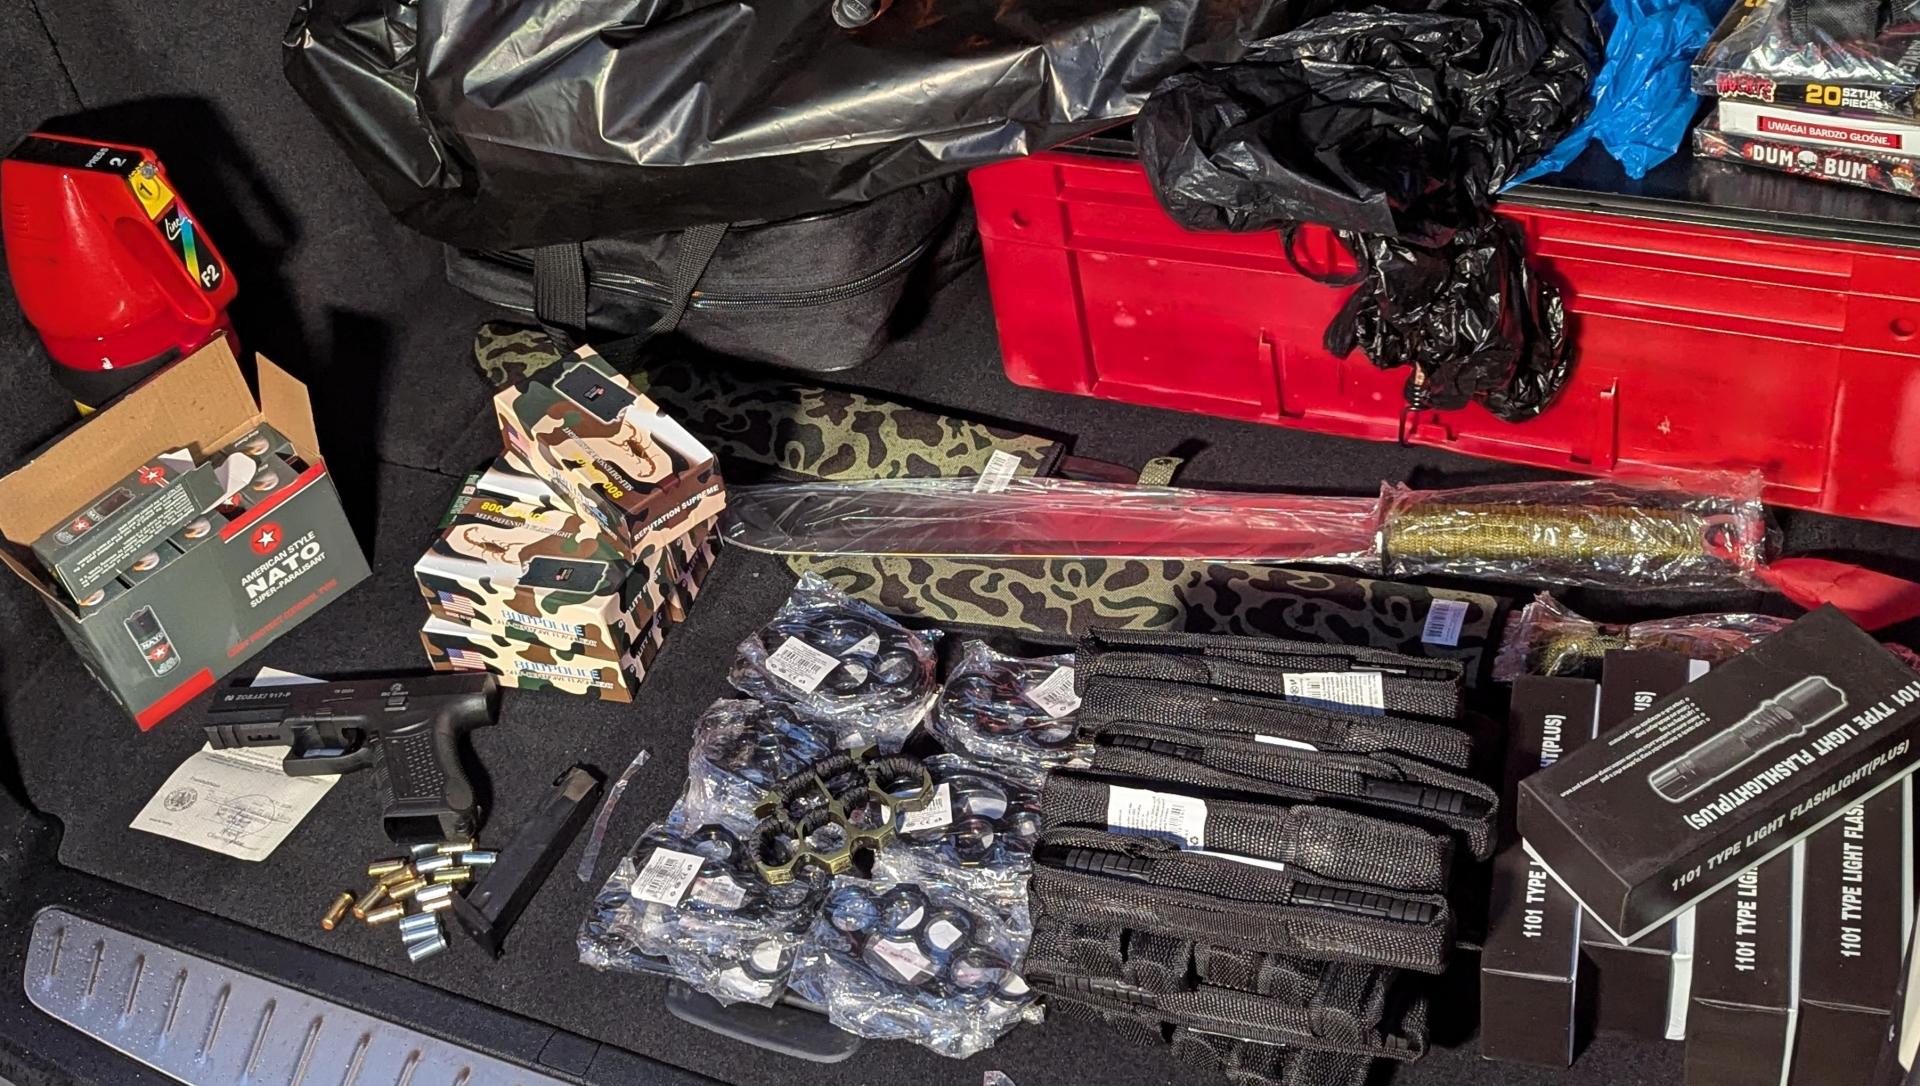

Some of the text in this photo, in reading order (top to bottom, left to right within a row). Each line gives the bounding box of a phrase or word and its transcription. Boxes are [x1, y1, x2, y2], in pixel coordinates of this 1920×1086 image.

[1805, 84, 1841, 106] 20
[1842, 87, 1881, 100] SZTUK
[1767, 120, 1807, 134] UWAGA!
[1809, 127, 1848, 140] BARDZO
[85, 148, 109, 167] PRESS
[109, 157, 127, 167] 2
[1753, 144, 1793, 167] DUM
[1824, 158, 1867, 180] BUM
[139, 183, 153, 196] 1
[201, 264, 219, 288] F2
[603, 481, 623, 499] 800
[480, 501, 503, 514] 800
[634, 483, 720, 542] REPUTATION SUPREME
[241, 531, 316, 587] AMERICAN STYLE
[245, 541, 321, 600] NATO
[618, 590, 644, 628] QALITY
[1852, 701, 1897, 730] TYPE
[1812, 722, 1859, 757] LIGHT
[1683, 750, 1816, 831] FLASHLIGHT(PLUS)
[1672, 738, 1910, 892] 1101 TYPE LIGHT FLASHLIGHT(PLUS)
[1843, 842, 1864, 882] LIGHT
[1526, 870, 1547, 903] TYPE
[1737, 900, 1757, 935] TYPE
[1841, 886, 1862, 920] TYPE
[1523, 910, 1544, 938] 1101
[1735, 940, 1756, 972] 1101
[1841, 926, 1861, 958] 1101
